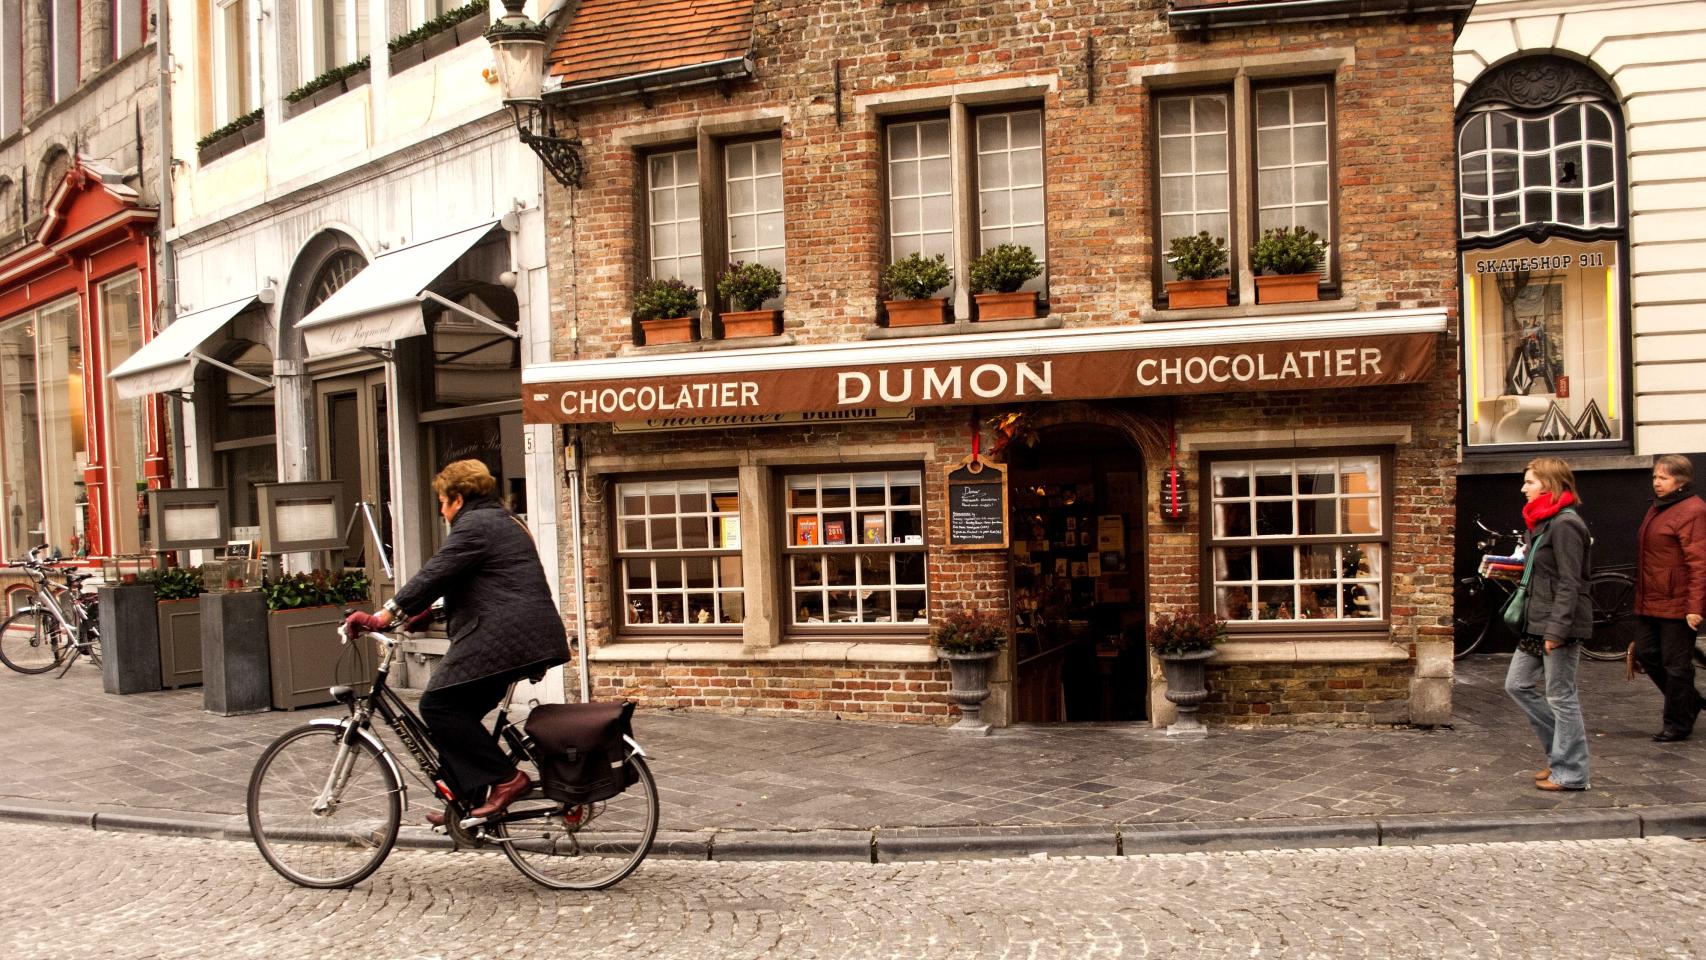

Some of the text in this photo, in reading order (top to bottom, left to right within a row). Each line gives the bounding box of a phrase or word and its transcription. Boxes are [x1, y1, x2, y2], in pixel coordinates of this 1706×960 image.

[1476, 253, 1604, 274] SKATESHOP 911
[560, 347, 1383, 415] CHOCOLATIER DUMON CHOCOLATIER
[527, 437, 532, 450] 5
